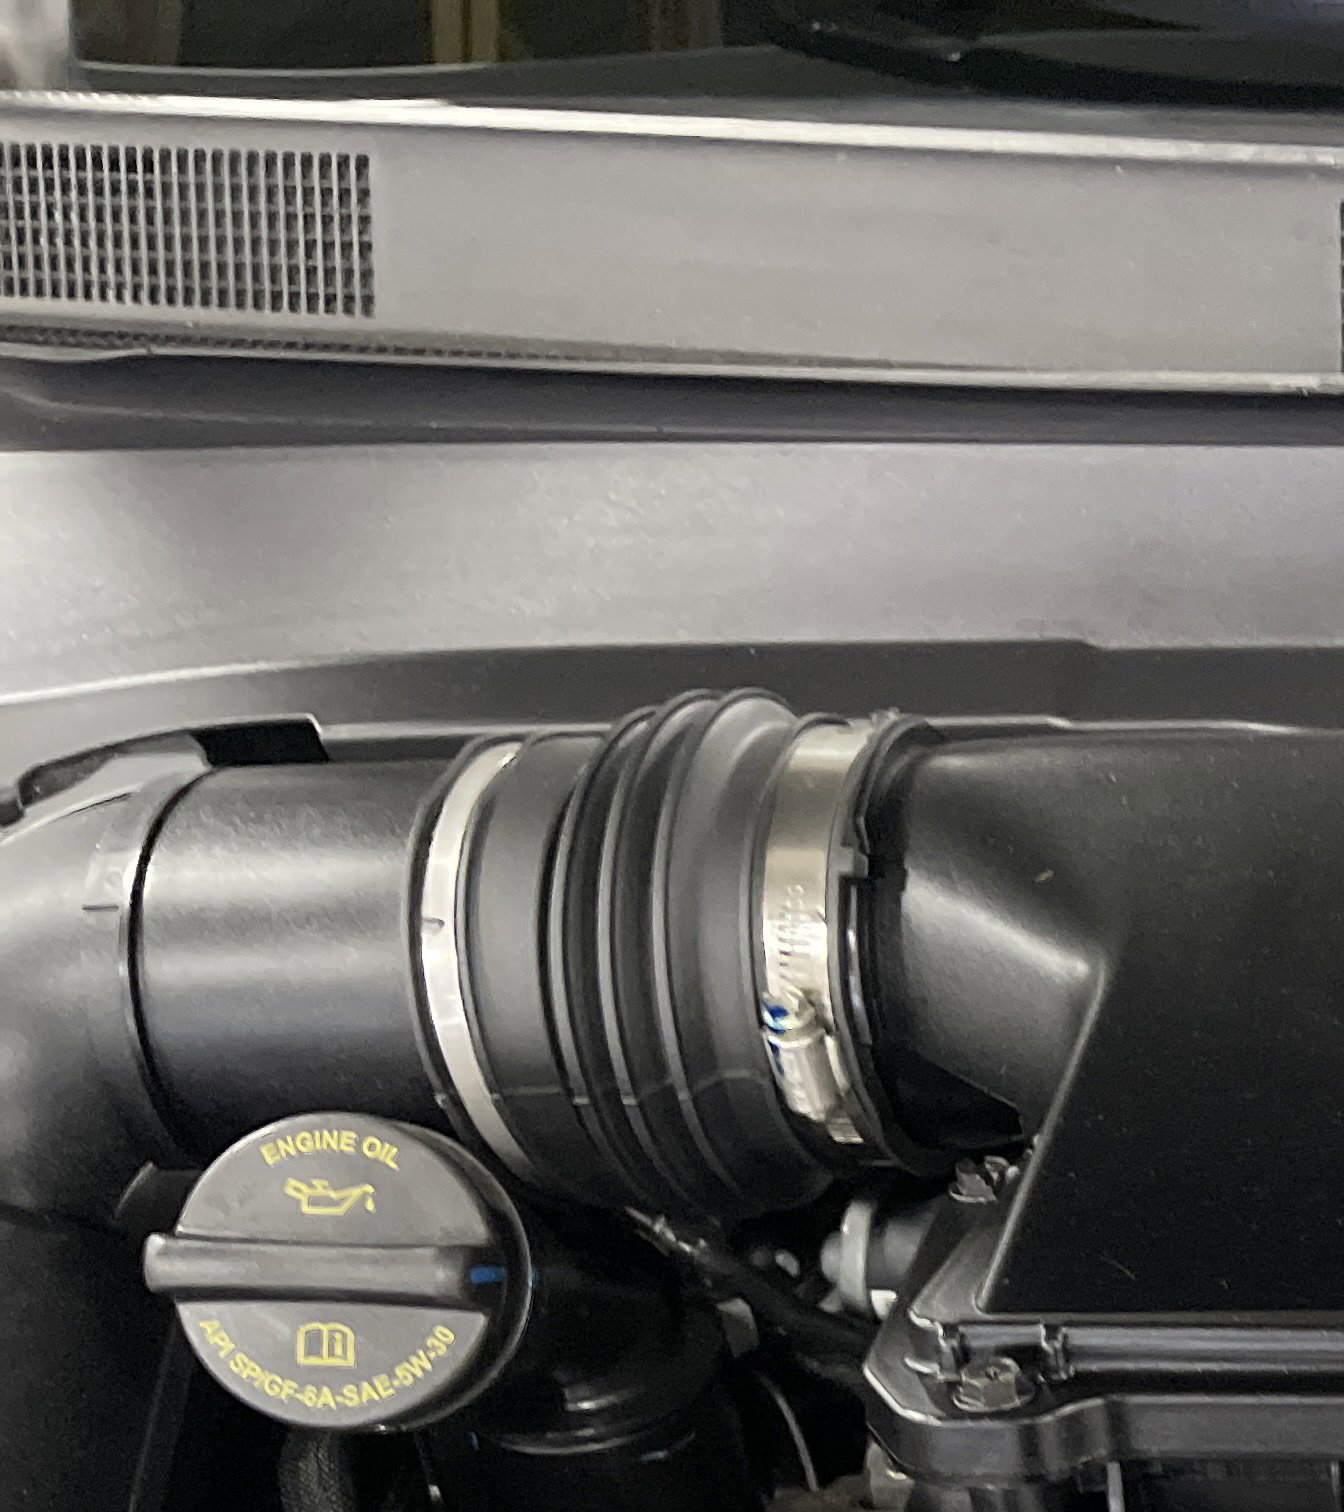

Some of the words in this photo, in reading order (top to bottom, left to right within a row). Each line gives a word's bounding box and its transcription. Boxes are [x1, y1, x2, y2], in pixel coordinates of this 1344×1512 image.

[260, 1130, 357, 1166] ENGINE
[362, 1136, 400, 1170] OIL
[199, 1319, 235, 1359] API
